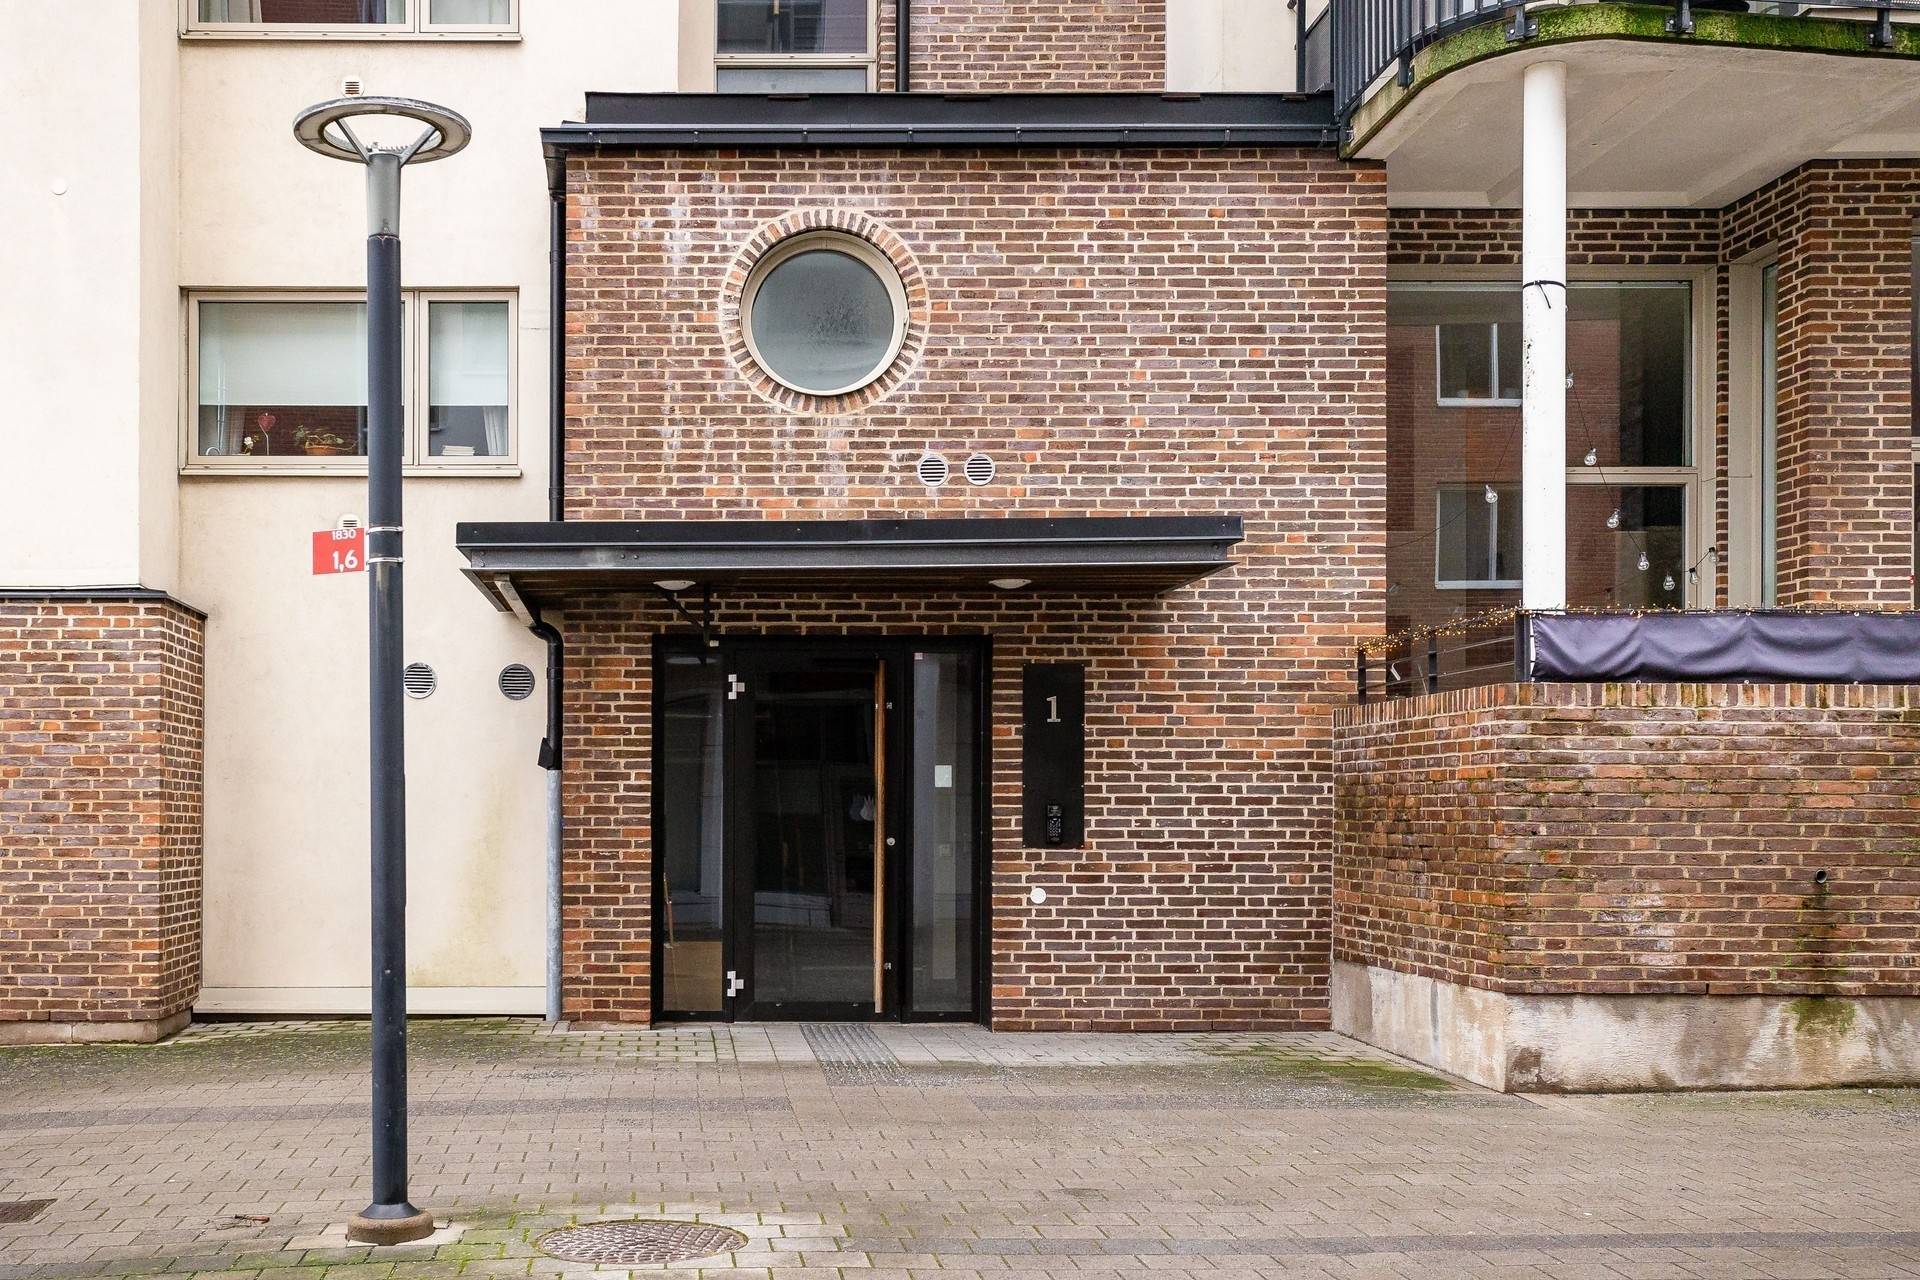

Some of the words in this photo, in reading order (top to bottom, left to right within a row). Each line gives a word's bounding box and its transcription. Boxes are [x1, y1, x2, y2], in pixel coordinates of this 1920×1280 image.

[332, 529, 357, 541] 1830
[332, 549, 358, 573] 1,6
[1046, 695, 1062, 723] 1
